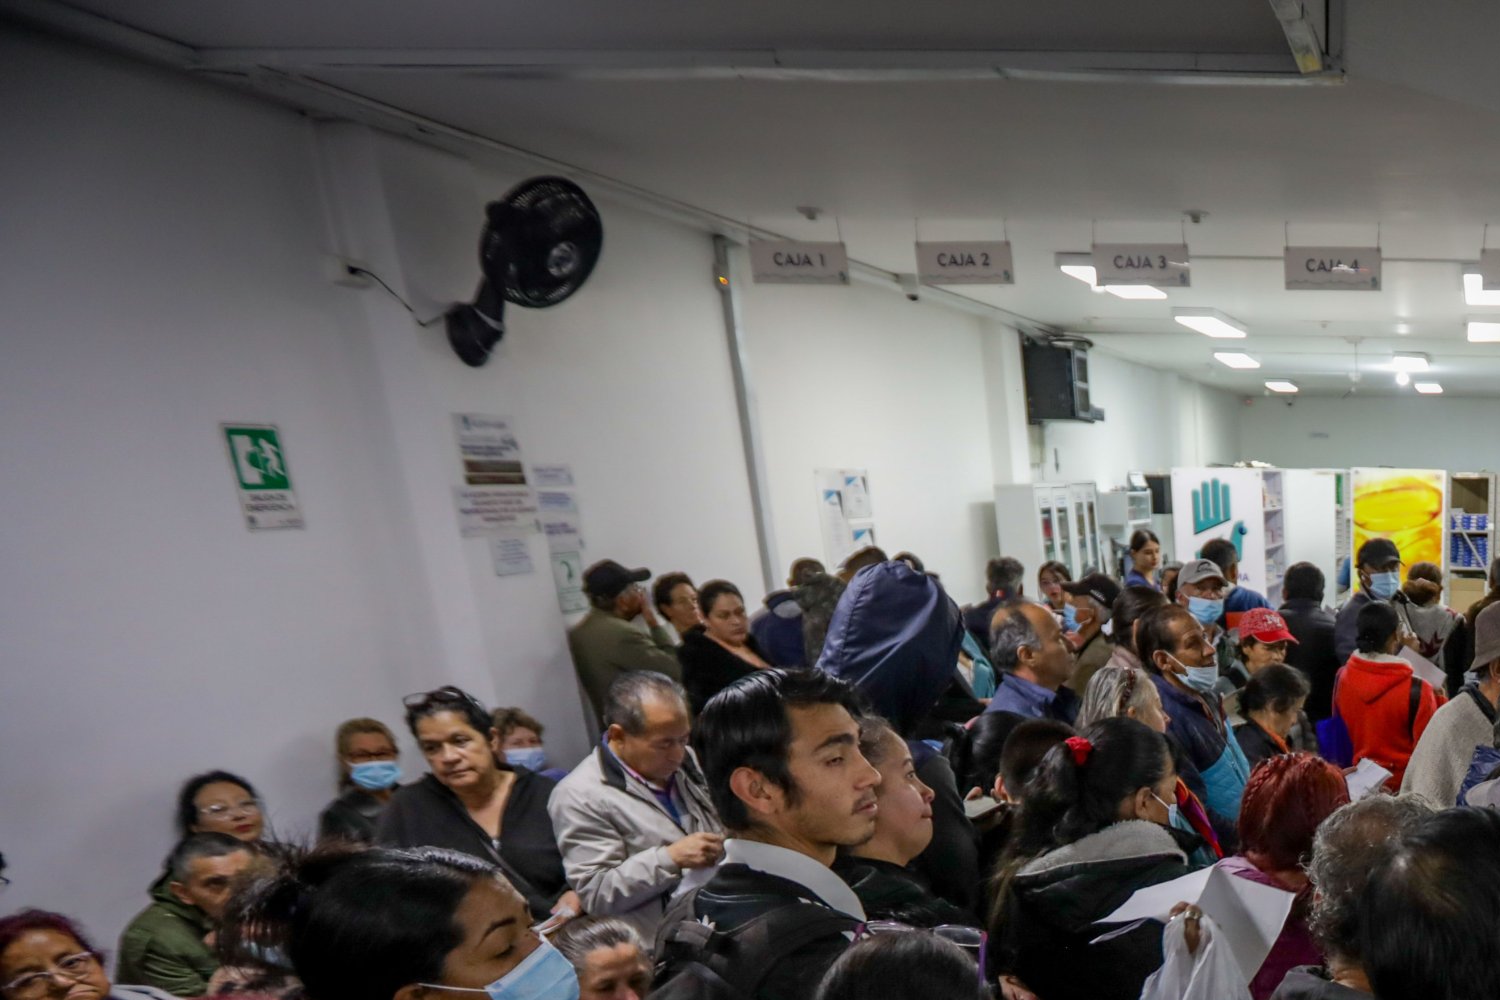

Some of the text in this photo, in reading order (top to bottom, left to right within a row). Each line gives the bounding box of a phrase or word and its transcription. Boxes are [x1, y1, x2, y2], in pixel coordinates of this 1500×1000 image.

[773, 252, 826, 267] CAJA 1
[937, 253, 990, 268] CAJA 2
[1113, 255, 1167, 270] CAJA 3
